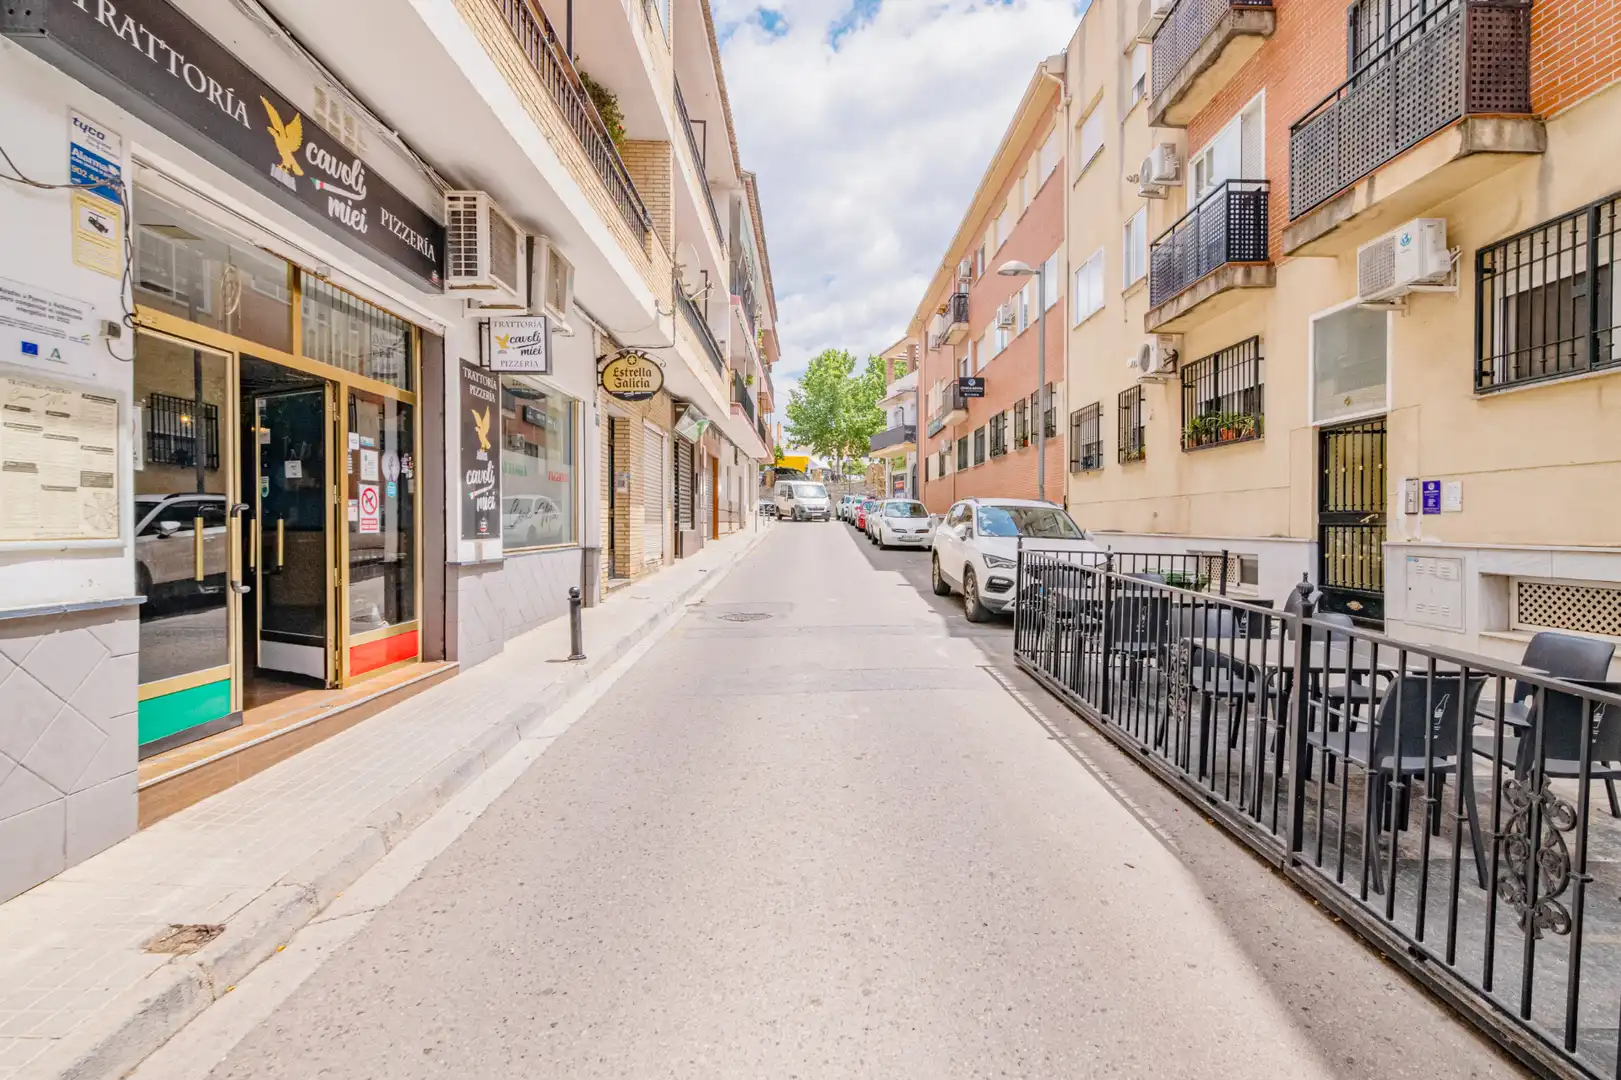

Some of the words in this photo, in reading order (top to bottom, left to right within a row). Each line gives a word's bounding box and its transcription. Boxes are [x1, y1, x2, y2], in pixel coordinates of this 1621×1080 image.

[72, 117, 105, 141] tyco
[305, 142, 367, 201] cavoli
[328, 196, 368, 234] miei
[380, 207, 436, 262] PIZZERÍA
[509, 331, 542, 345] cavoli
[520, 346, 543, 356] miei
[613, 367, 652, 377] Estrella
[614, 377, 650, 388] Galicia
[466, 460, 495, 488] cavoli
[476, 491, 496, 512] miei
